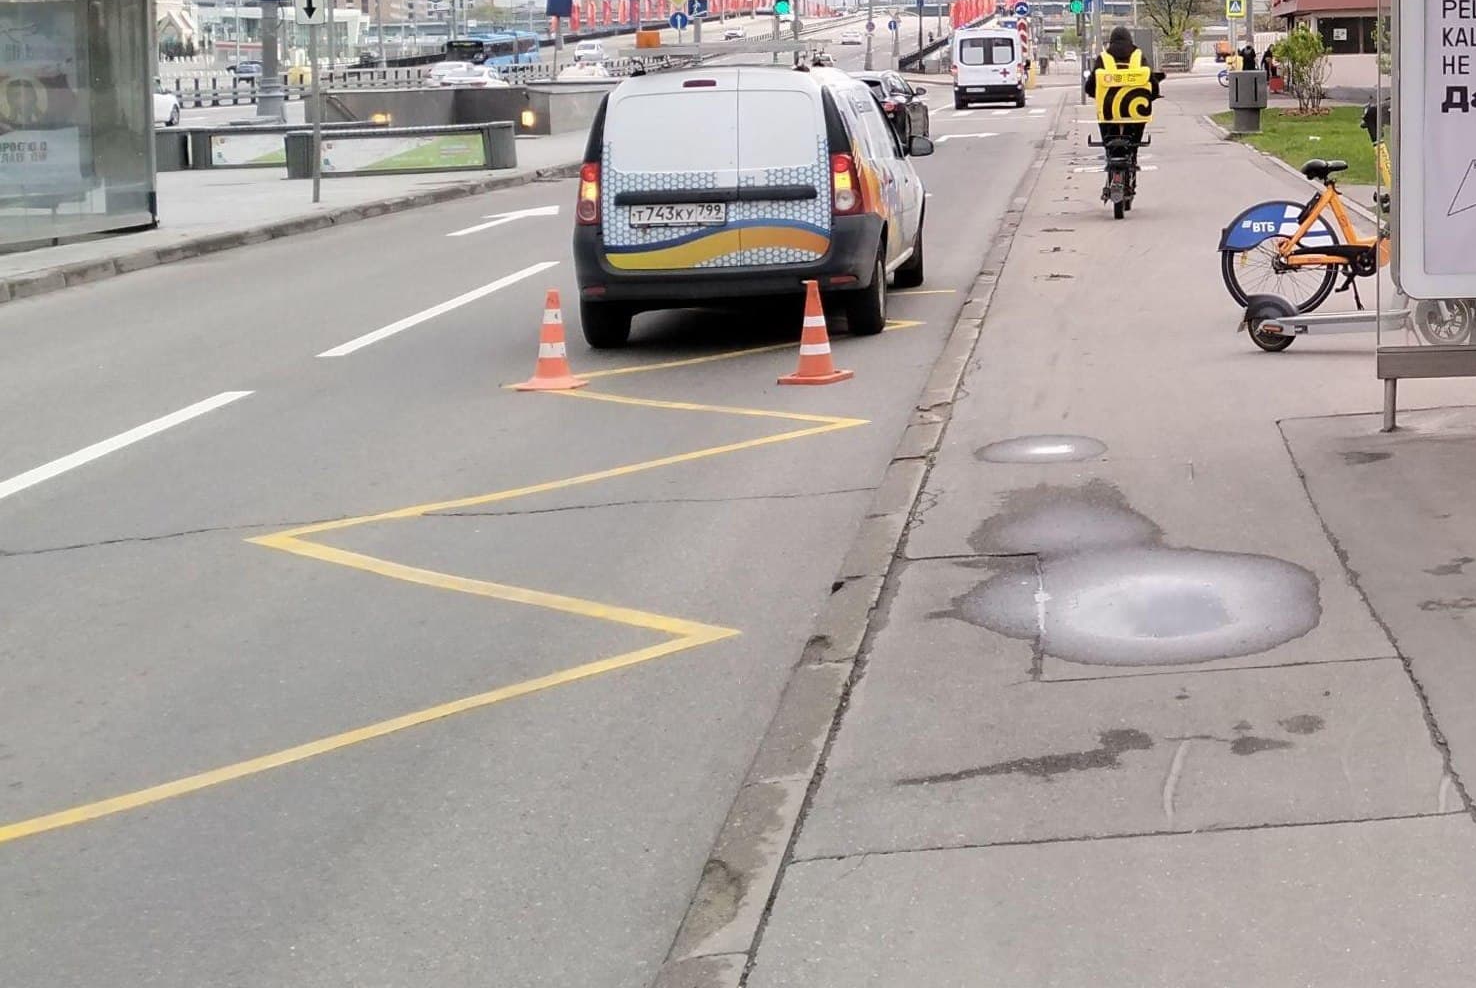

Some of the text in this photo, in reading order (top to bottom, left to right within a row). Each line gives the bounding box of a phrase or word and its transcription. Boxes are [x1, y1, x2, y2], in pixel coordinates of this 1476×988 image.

[1442, 55, 1470, 75] НЕ
[697, 204, 722, 216] 799
[1252, 221, 1276, 233] ВТБ
